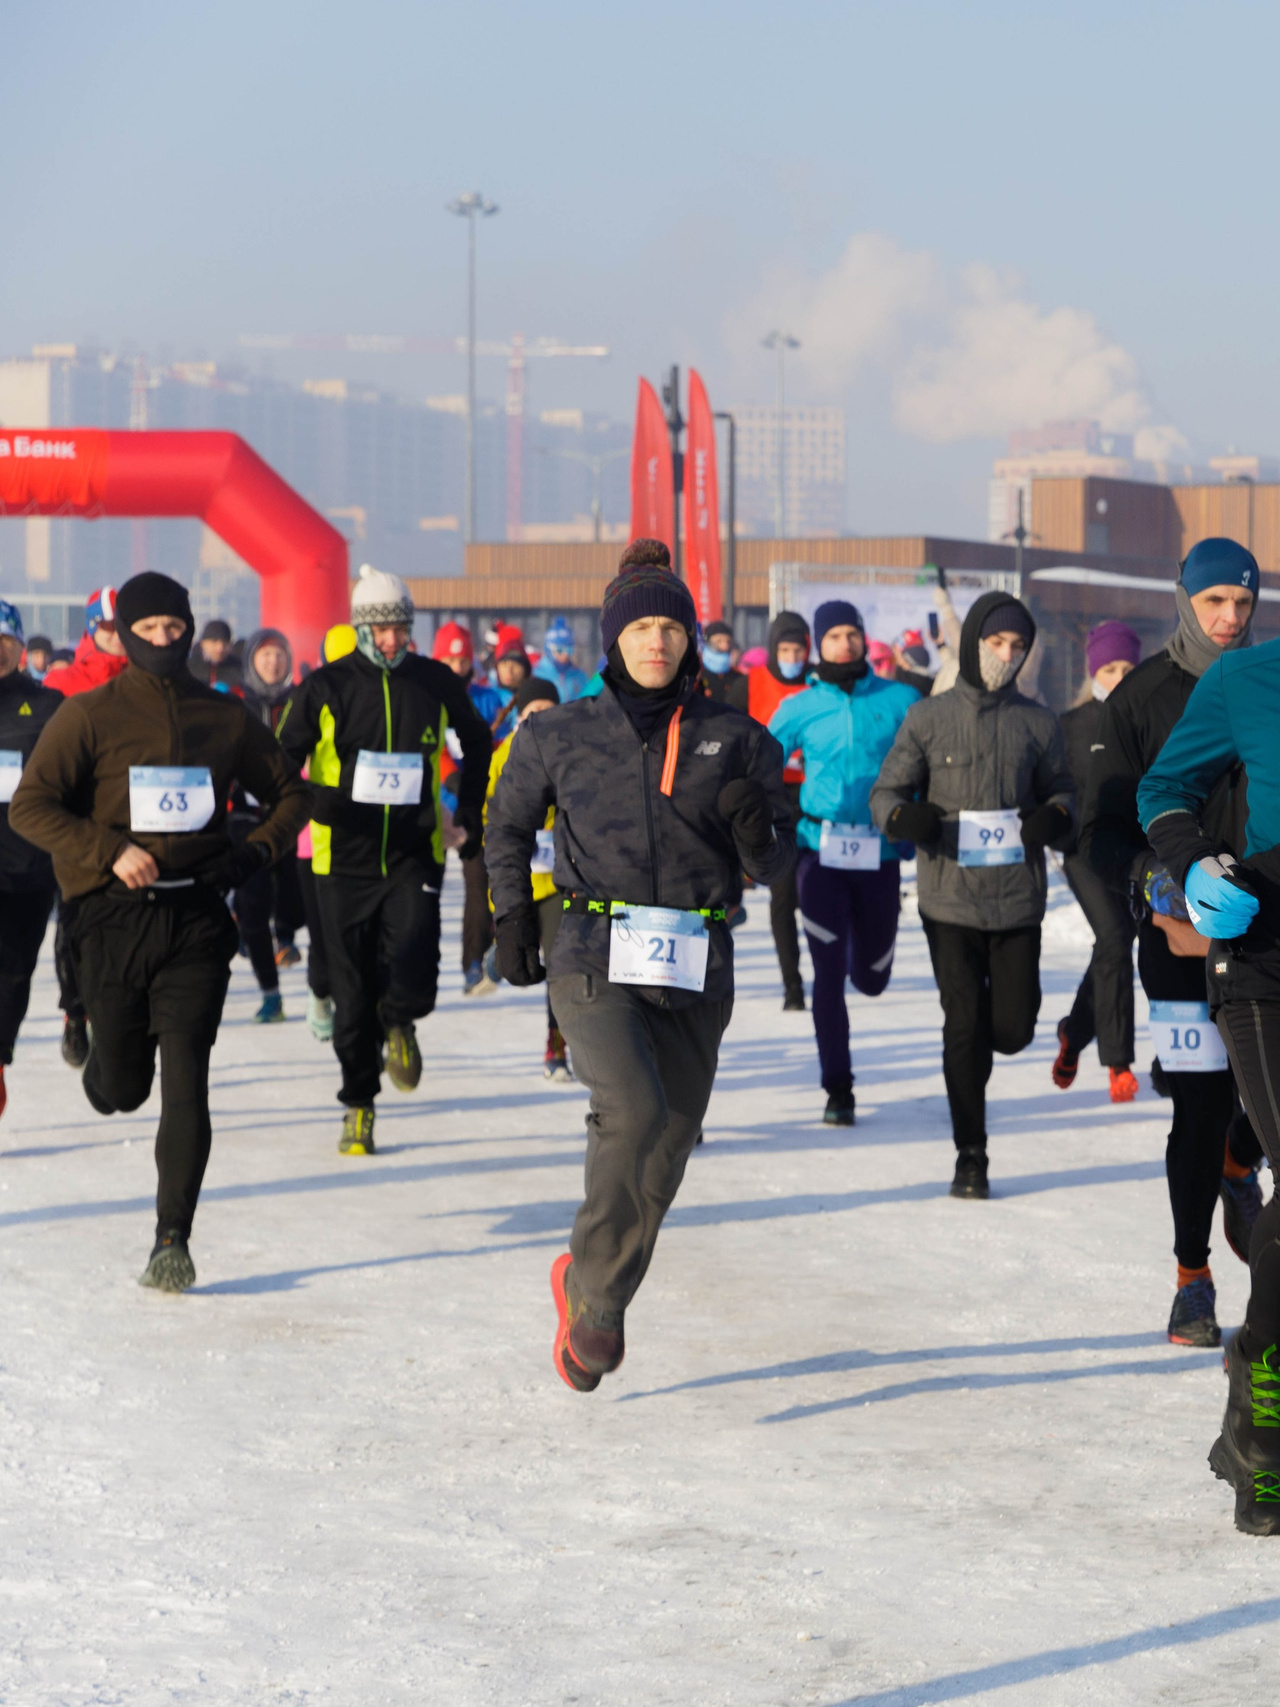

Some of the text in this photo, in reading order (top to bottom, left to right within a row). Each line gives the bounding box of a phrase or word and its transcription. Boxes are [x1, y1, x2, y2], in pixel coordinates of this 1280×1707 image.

[14, 435, 77, 460] Банк
[377, 772, 400, 789] 73
[159, 792, 188, 812] 63
[841, 841, 861, 856] 19
[648, 937, 677, 964] 21
[1170, 1026, 1202, 1050] 10
